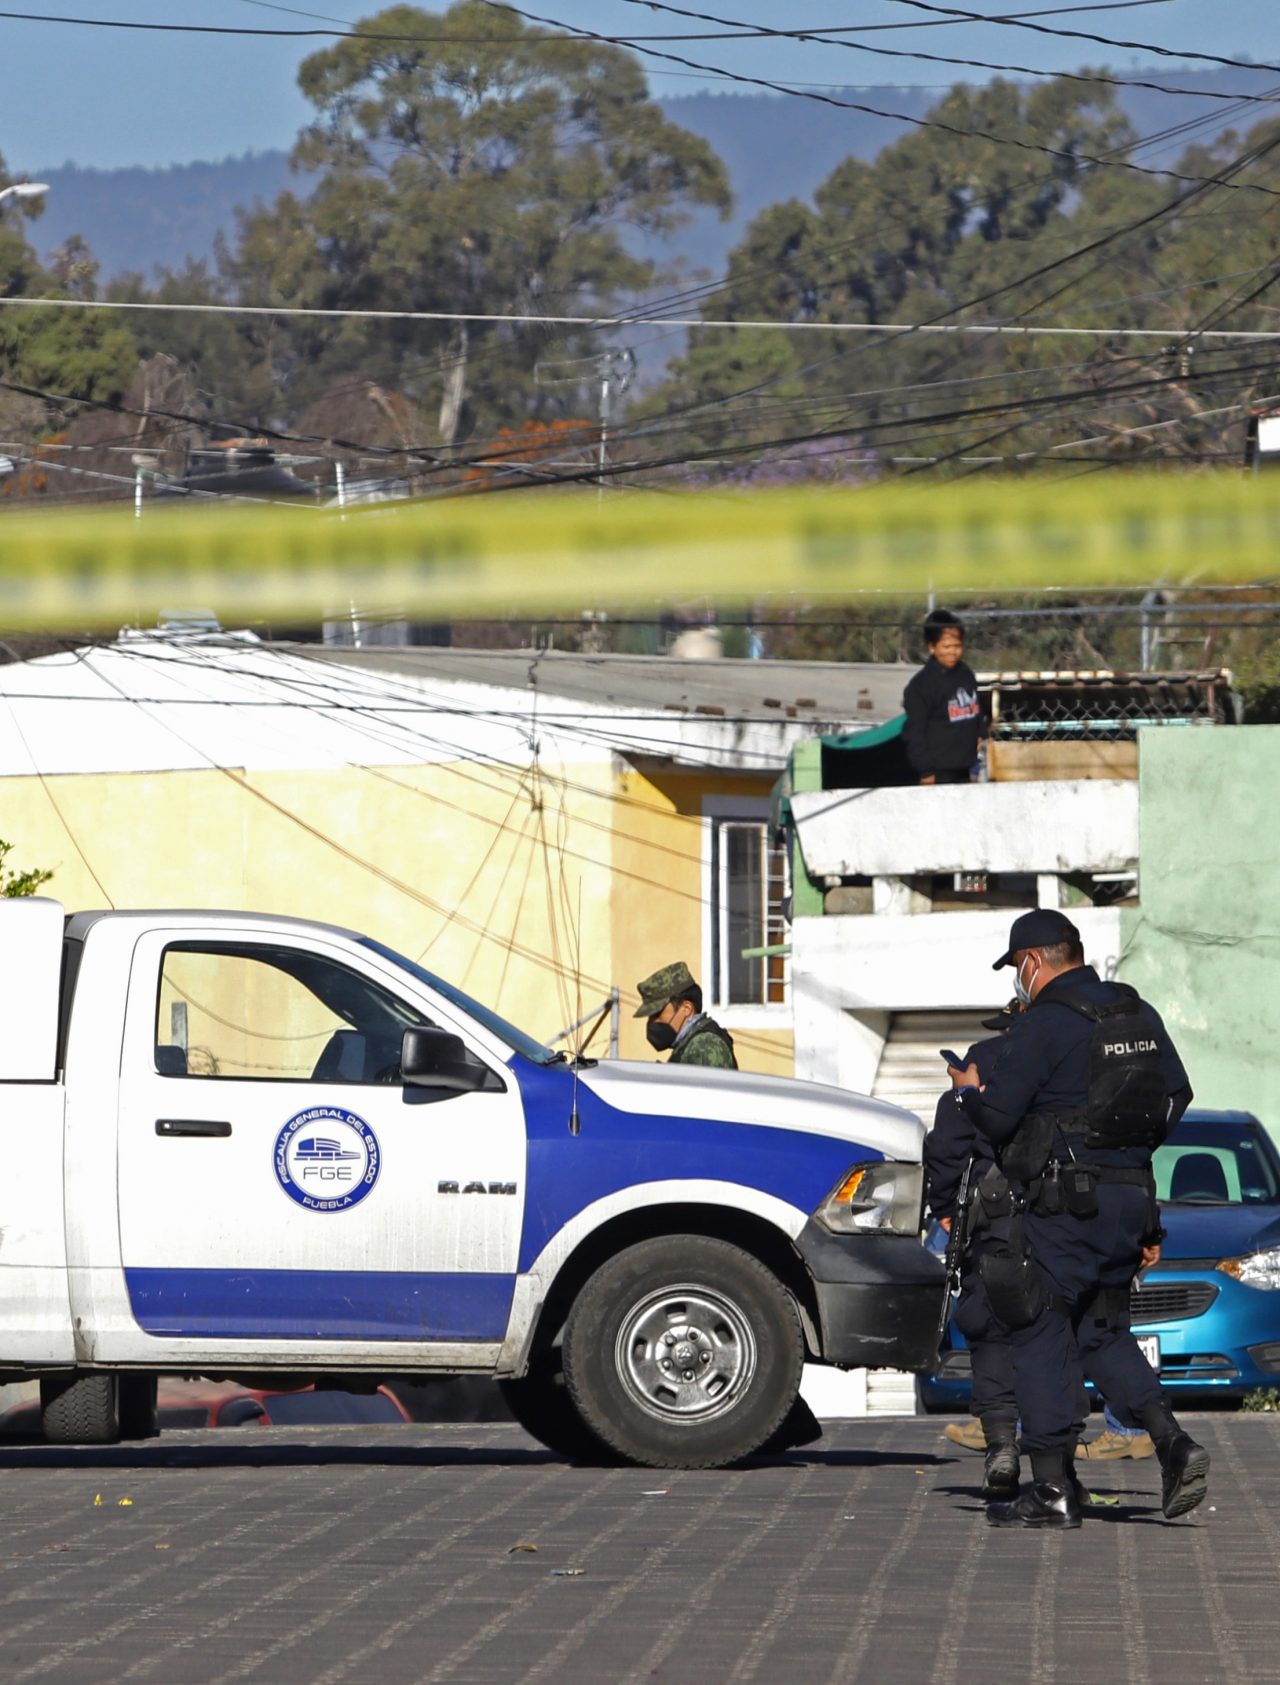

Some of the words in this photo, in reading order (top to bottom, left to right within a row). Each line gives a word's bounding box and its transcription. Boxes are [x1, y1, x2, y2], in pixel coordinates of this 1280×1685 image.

[1104, 1040, 1158, 1056] POLICIA
[289, 1109, 344, 1131] GENERAL
[346, 1115, 365, 1136] DEL
[364, 1135, 378, 1185] ESTADO
[303, 1166, 352, 1181] FGE
[437, 1180, 517, 1195] RAM
[302, 1195, 353, 1210] PUEBLA
